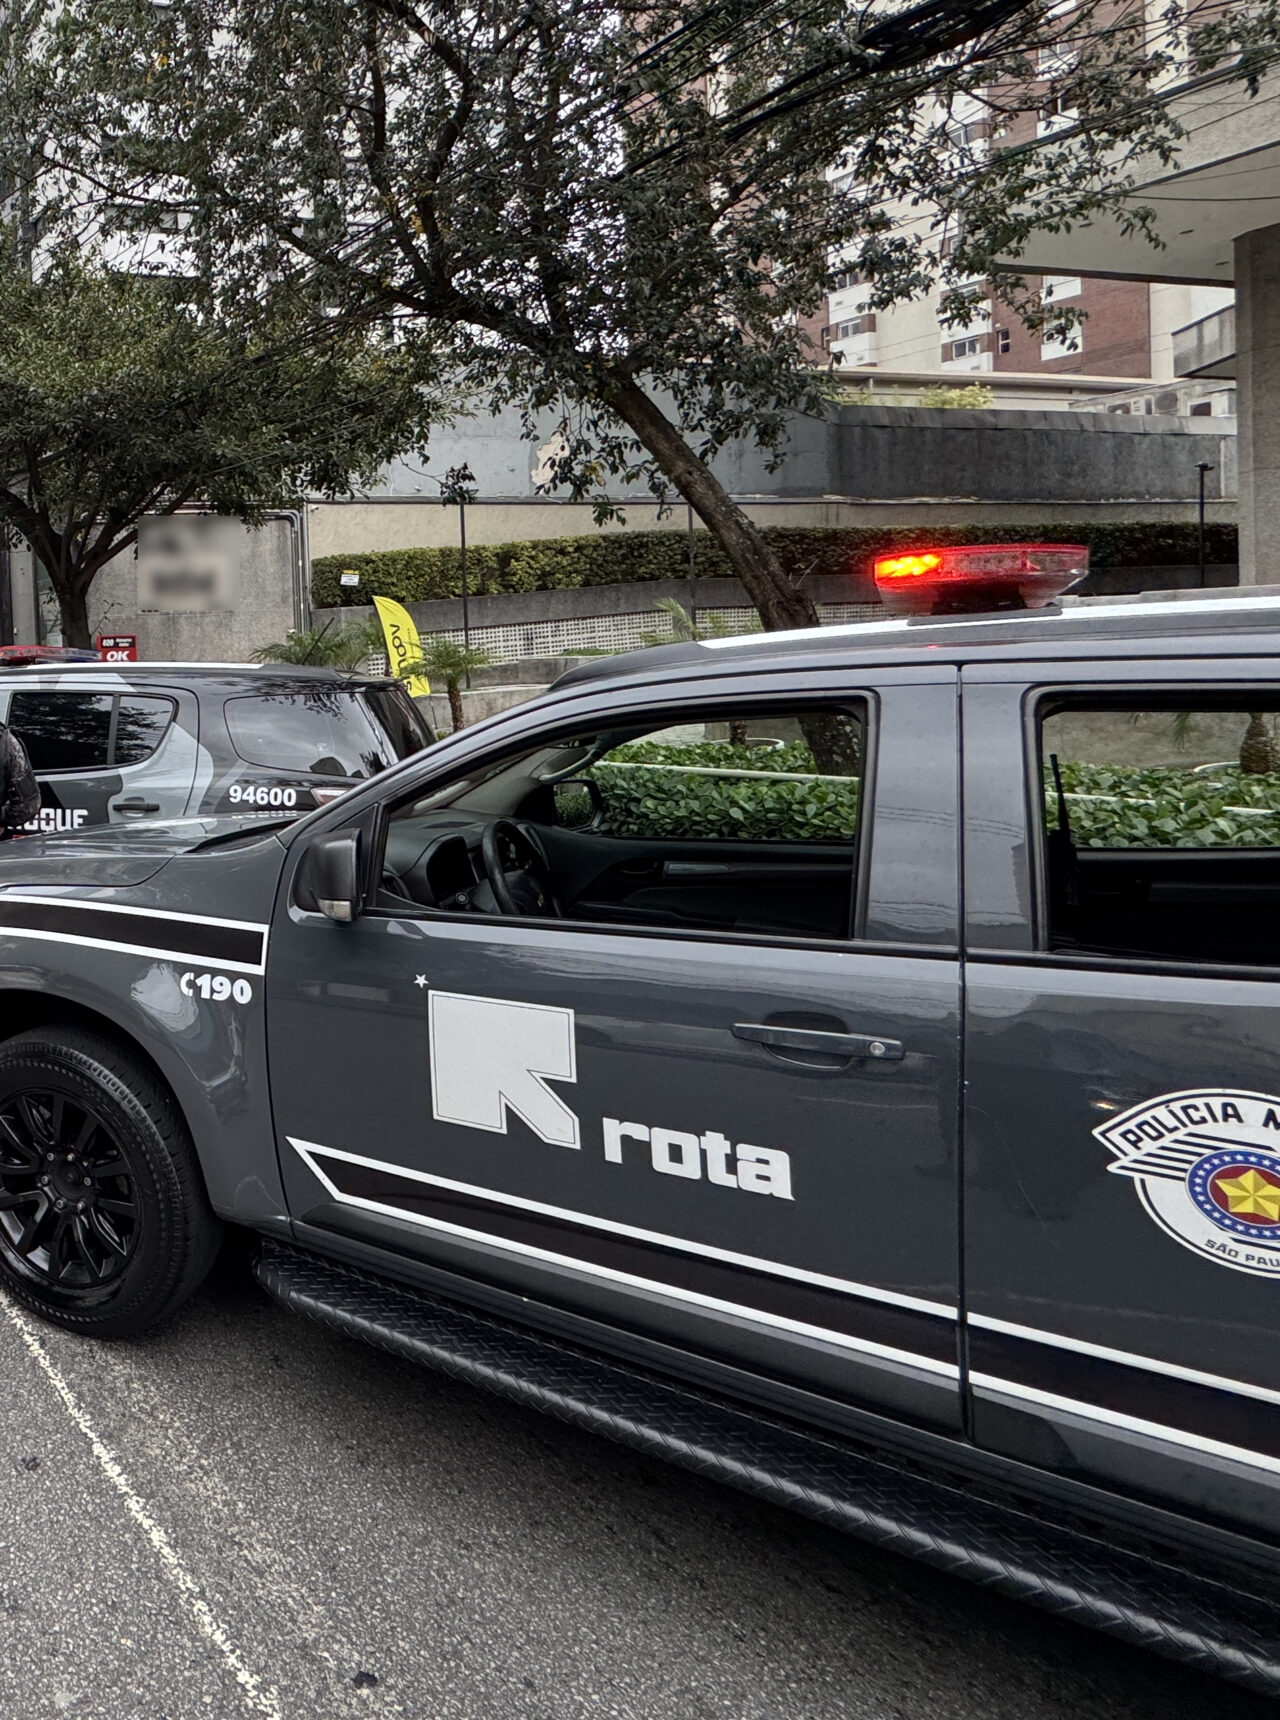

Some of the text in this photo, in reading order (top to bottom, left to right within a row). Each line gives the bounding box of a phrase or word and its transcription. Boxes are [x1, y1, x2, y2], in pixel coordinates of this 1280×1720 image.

[106, 651, 130, 661] OK
[229, 785, 297, 807] 94600
[1119, 1102, 1244, 1151] POLÍCIA
[602, 1117, 796, 1201] rota
[1204, 1239, 1240, 1259] SÃO
